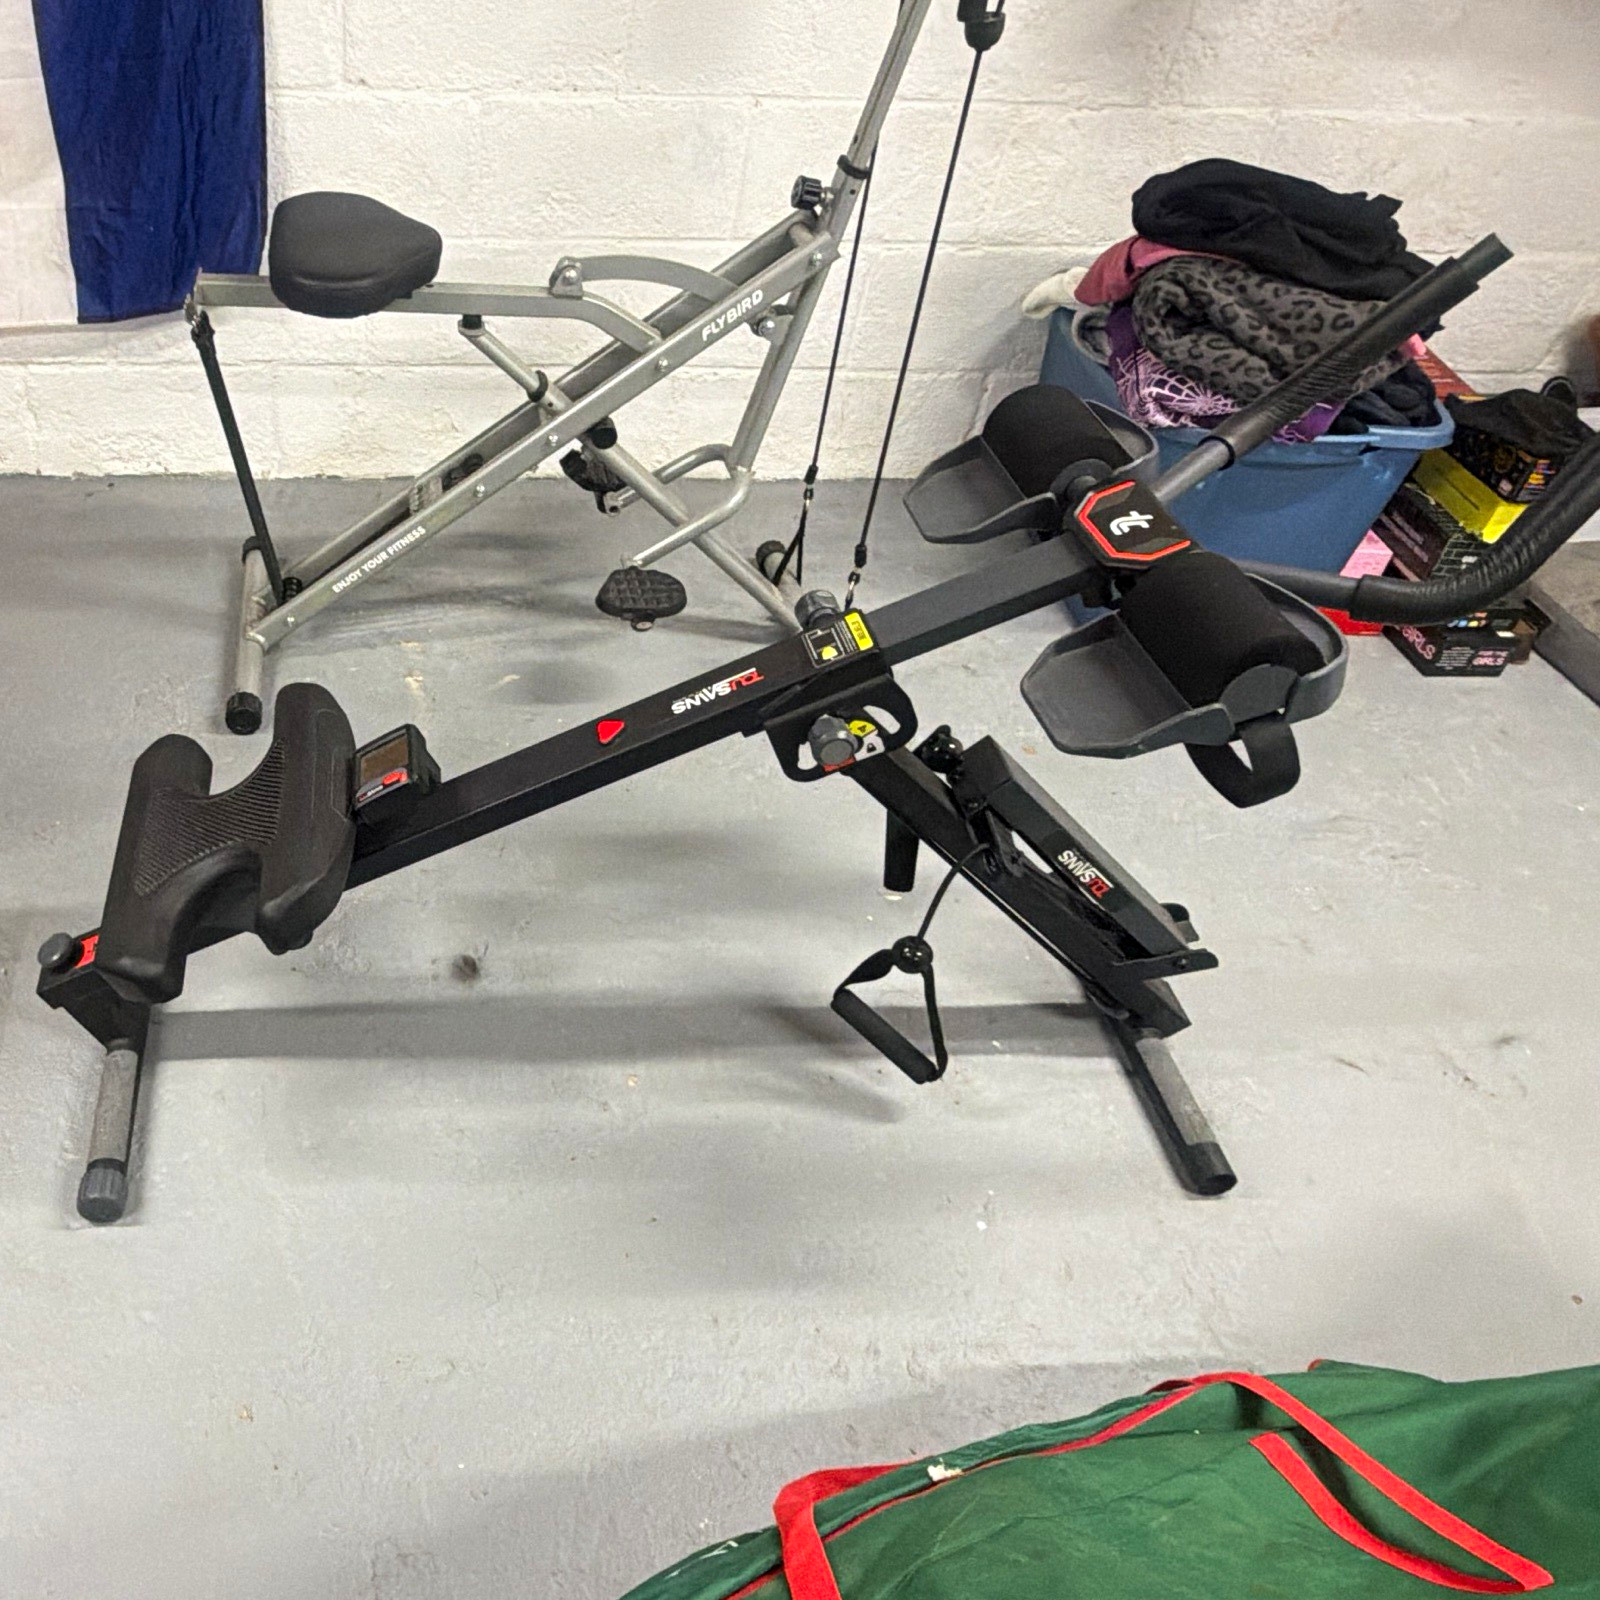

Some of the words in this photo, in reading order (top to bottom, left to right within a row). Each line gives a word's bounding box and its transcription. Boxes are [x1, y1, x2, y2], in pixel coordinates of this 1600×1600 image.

[702, 289, 763, 341] FLYBIRD
[332, 569, 362, 593] ENJOY
[361, 551, 389, 572] YOUR
[386, 525, 426, 555] FITNESS
